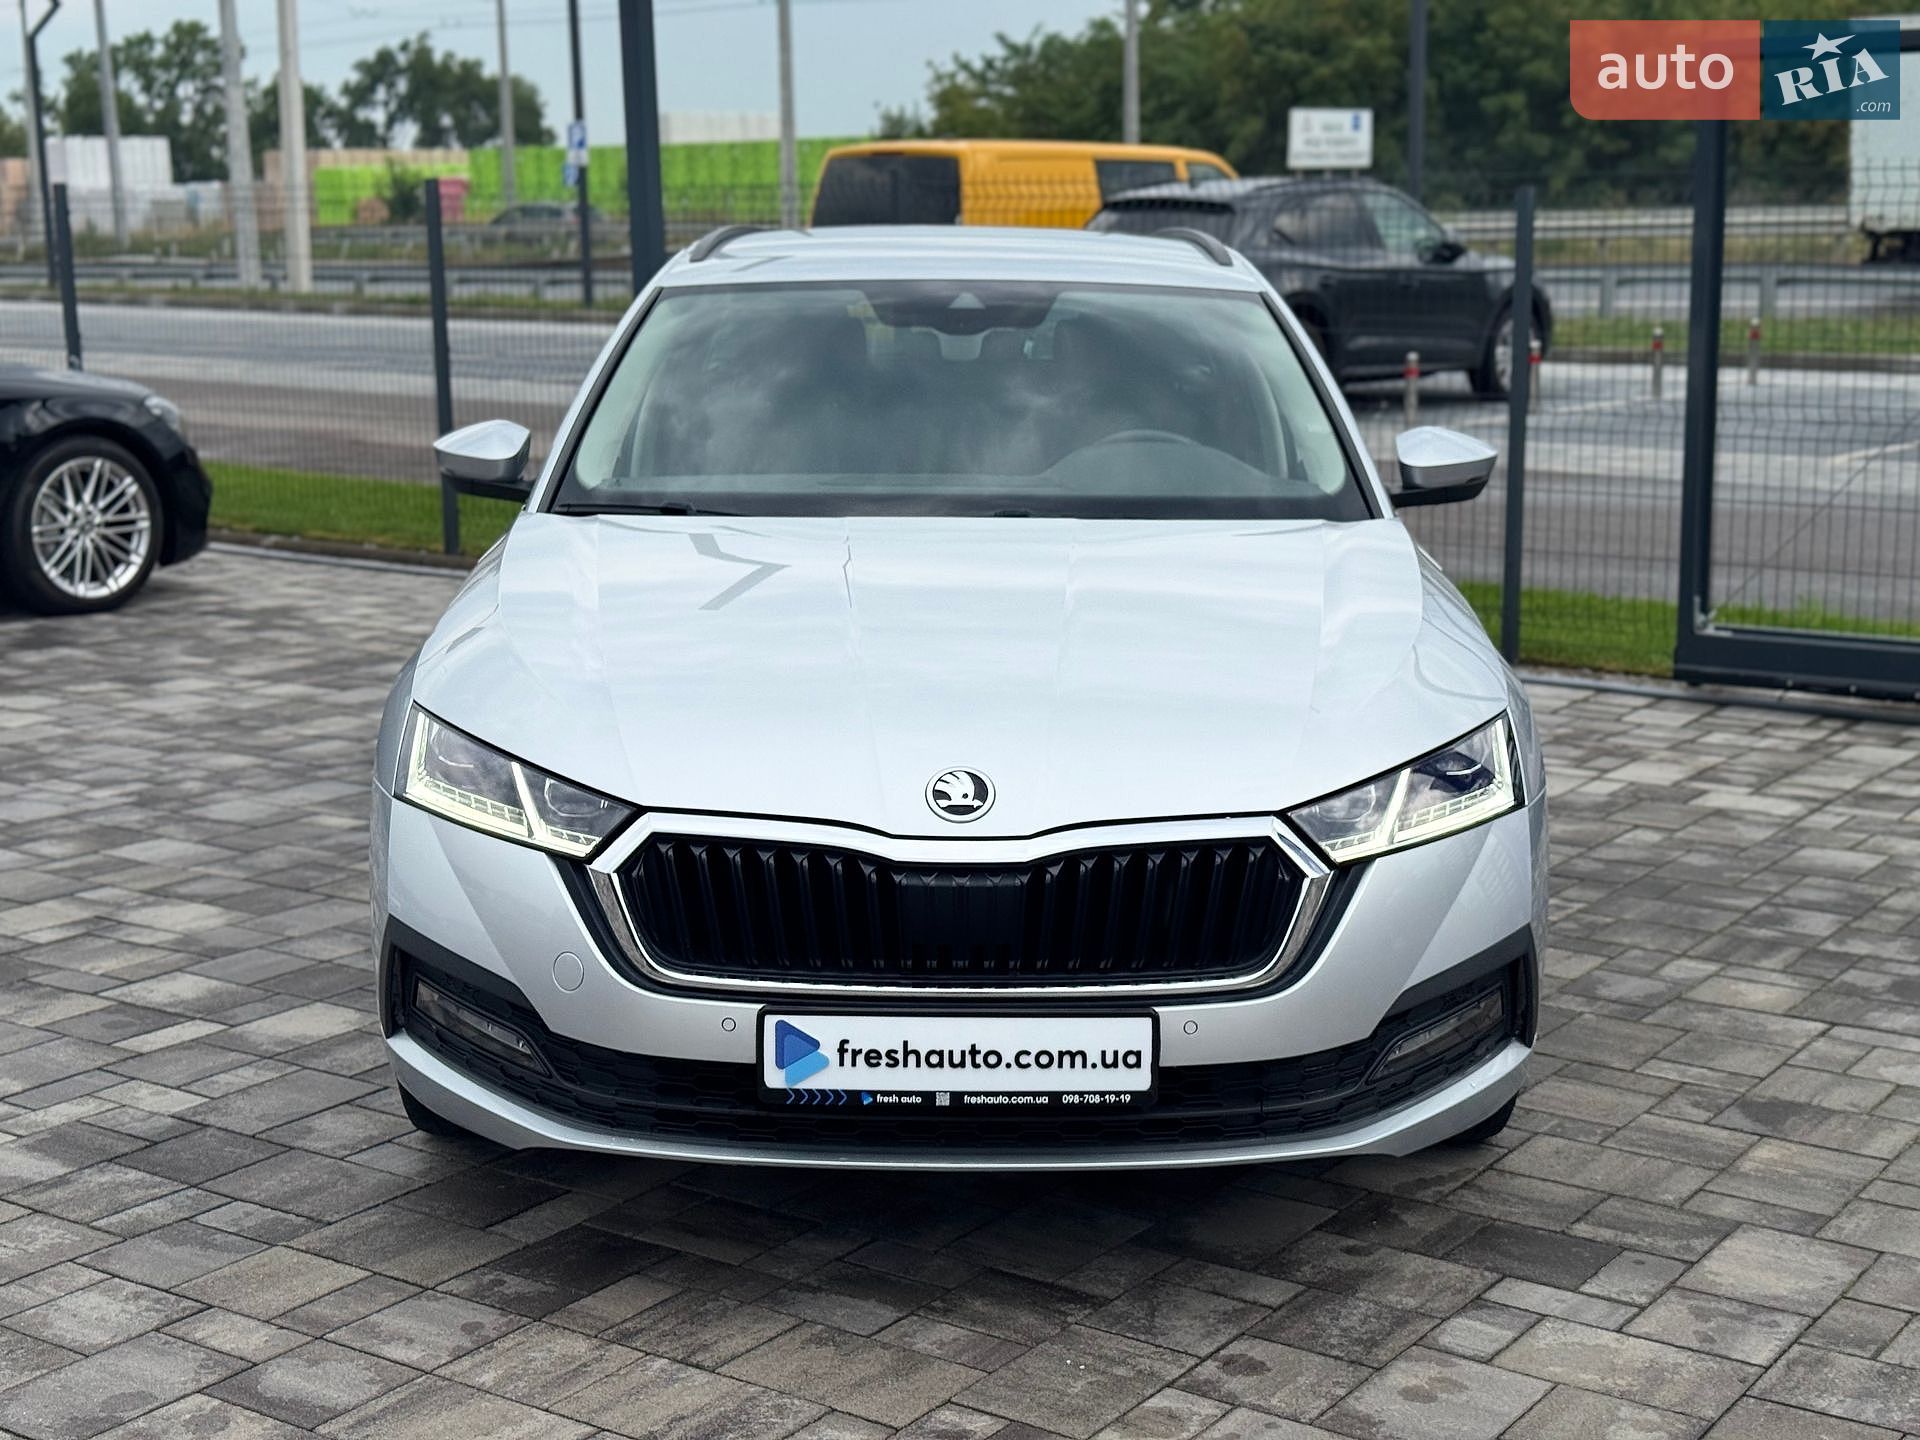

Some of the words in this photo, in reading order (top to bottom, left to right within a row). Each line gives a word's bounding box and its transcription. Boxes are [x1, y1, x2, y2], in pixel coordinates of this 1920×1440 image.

[836, 1038, 1142, 1070] freshauto.com.ua
[876, 1094, 899, 1104] fresh
[900, 1095, 922, 1104] auto
[963, 1094, 1049, 1105] freshauto.com.ua
[1062, 1093, 1132, 1105] 098-708-19-19
